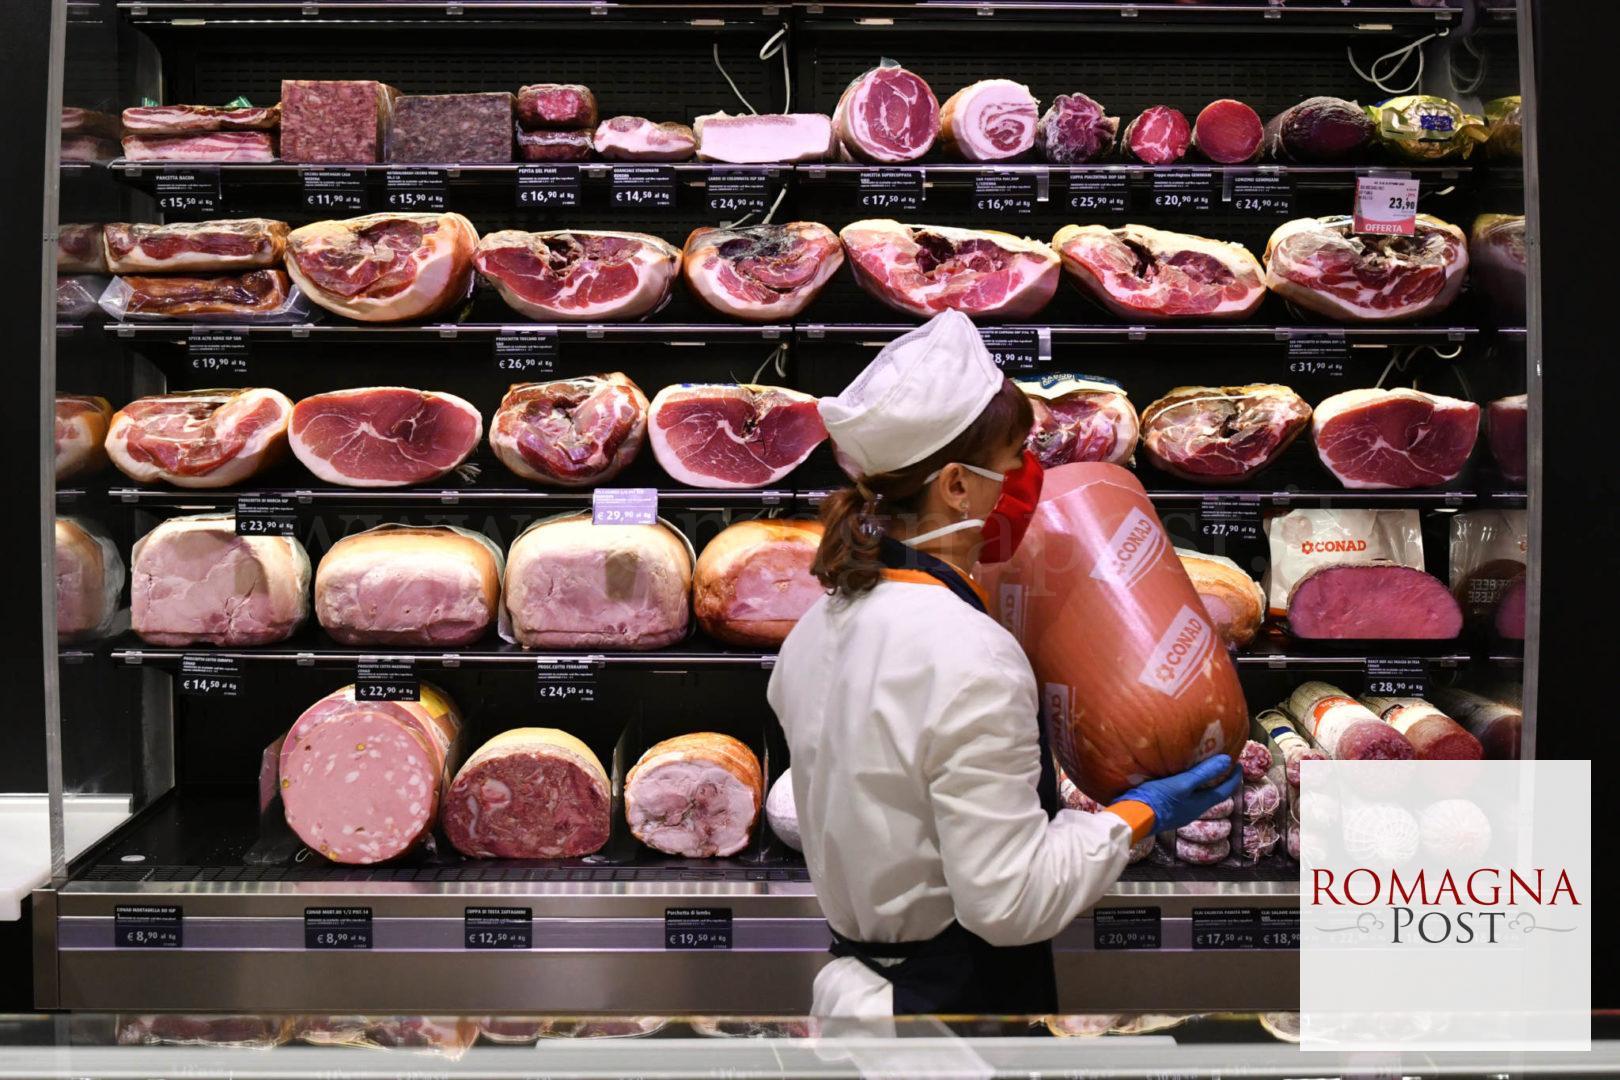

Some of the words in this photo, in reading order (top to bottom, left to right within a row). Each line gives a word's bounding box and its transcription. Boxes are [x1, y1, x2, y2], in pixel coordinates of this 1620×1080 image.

[308, 196, 314, 204] €
[316, 194, 344, 206] 11,90
[390, 194, 396, 204] €
[398, 194, 426, 206] 15,90
[520, 192, 528, 202] €
[530, 190, 558, 202] 16,90
[616, 192, 622, 202] €
[626, 190, 652, 202] 14,50
[862, 196, 870, 206] €
[872, 194, 898, 206] 17,50
[1072, 198, 1078, 206] €
[1080, 196, 1106, 208] 25,90
[1156, 196, 1162, 206] €
[1164, 194, 1192, 206] 20,90
[160, 198, 166, 208] €
[170, 198, 196, 208] 15,50
[710, 200, 716, 208] €
[720, 198, 746, 210] 24,90
[978, 200, 984, 210] €
[986, 198, 1014, 210] 16,90
[1236, 200, 1242, 210] €
[1244, 198, 1272, 210] 24,90
[1389, 197, 1415, 210] 23,90
[1365, 224, 1402, 232] OFFERTA
[192, 360, 200, 368] €
[202, 358, 228, 370] 19,90
[498, 360, 506, 368] €
[508, 358, 536, 370] 26,90
[1290, 364, 1296, 372] €
[1298, 362, 1326, 374] 31,90
[598, 512, 604, 520] €
[606, 510, 634, 522] 29,90
[240, 522, 246, 530] €
[250, 520, 276, 532] 23,90
[1202, 526, 1210, 534] €
[1212, 524, 1238, 536] 27,90
[1116, 518, 1153, 561] CONAD
[1315, 540, 1367, 552] CONAD
[1166, 617, 1203, 665] CONAD
[184, 680, 190, 690] €
[192, 680, 220, 692] 14,50
[360, 688, 366, 696] €
[368, 686, 396, 698] 22,90
[540, 688, 546, 696] €
[548, 686, 576, 698] 24,50
[1370, 684, 1376, 692] €
[1378, 682, 1406, 694] 28,90
[126, 932, 134, 942] €
[136, 930, 158, 944] 8,90
[316, 934, 324, 944] €
[326, 932, 348, 946] 8,90
[468, 934, 476, 944] €
[478, 932, 508, 944] 12,50
[670, 934, 676, 944] €
[680, 934, 708, 946] 19,50
[1100, 934, 1106, 944] €
[1108, 932, 1138, 946] 20,90
[1196, 936, 1204, 944] €
[1206, 934, 1234, 946] 17,50
[1263, 936, 1270, 944] €
